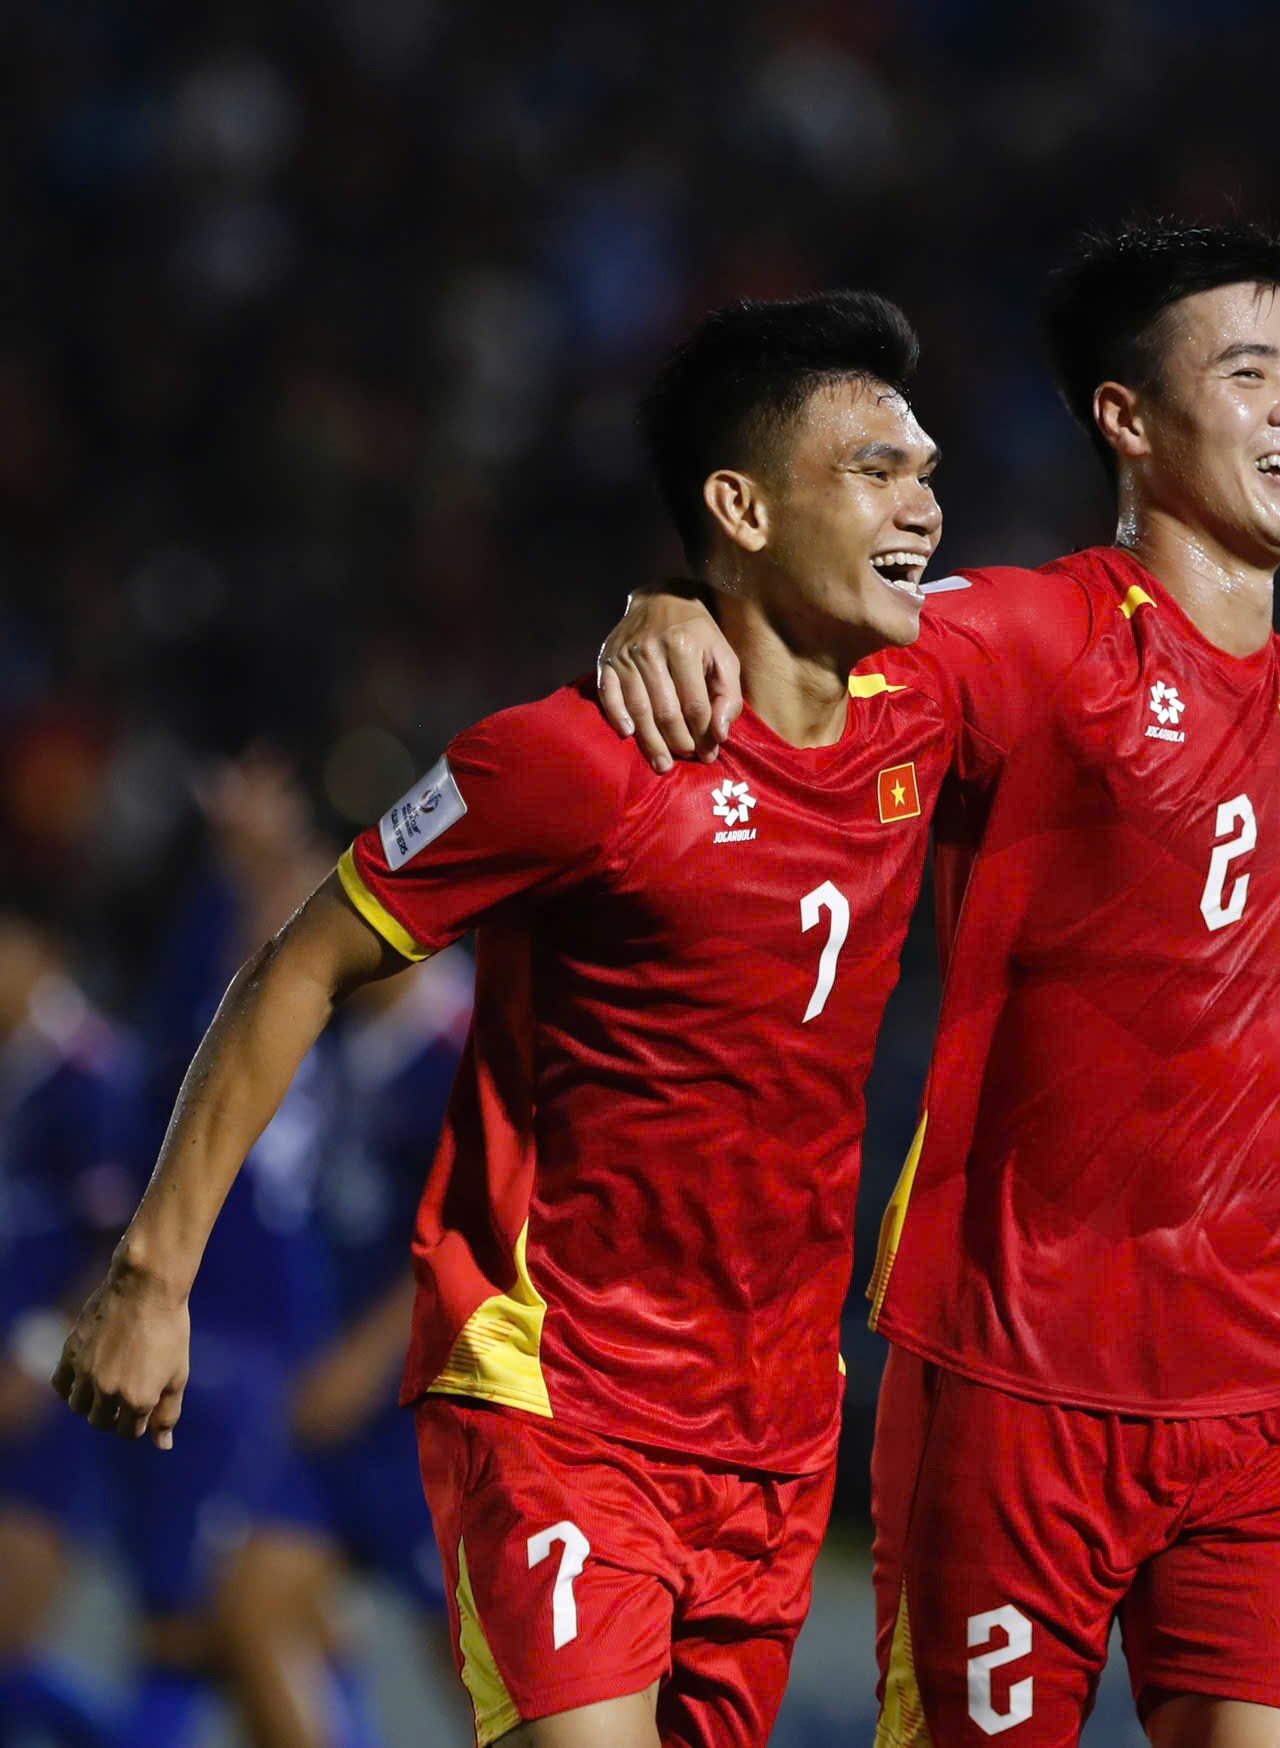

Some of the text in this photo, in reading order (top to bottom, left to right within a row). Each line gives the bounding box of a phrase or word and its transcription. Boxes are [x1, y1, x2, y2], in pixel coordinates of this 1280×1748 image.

[1200, 794, 1257, 931] 2
[800, 880, 850, 1023] 7
[527, 1521, 590, 1650] 7
[967, 1604, 1032, 1735] 2
